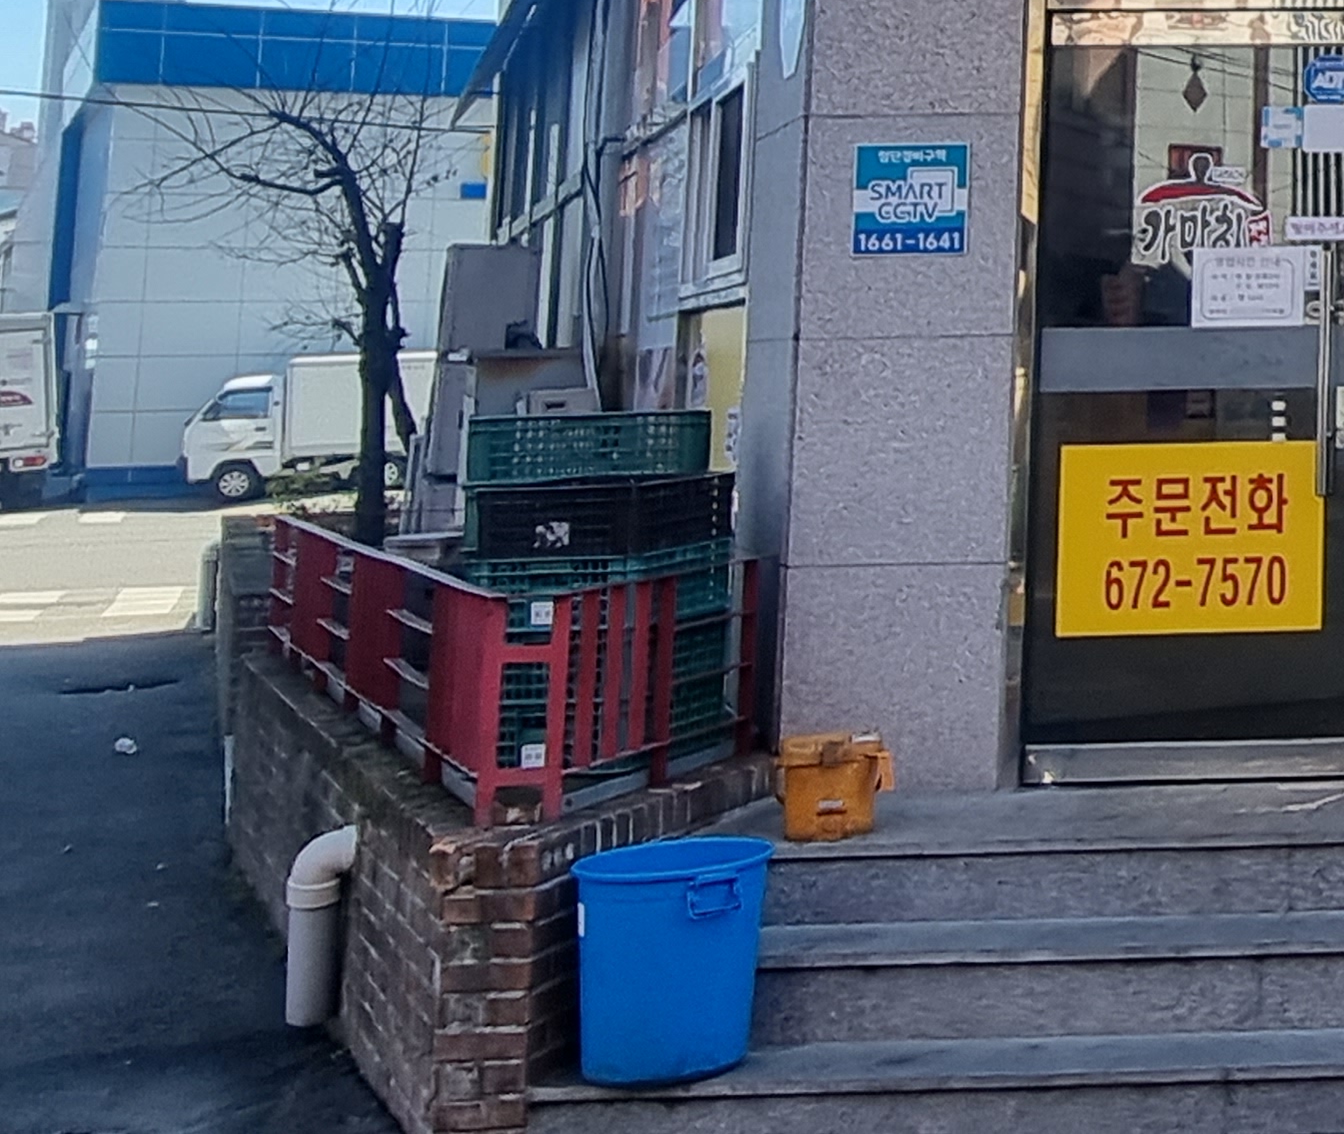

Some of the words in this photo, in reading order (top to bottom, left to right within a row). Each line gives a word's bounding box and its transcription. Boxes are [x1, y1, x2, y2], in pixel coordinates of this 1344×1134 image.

[870, 181, 948, 201] SMART
[877, 201, 939, 221] CCTV
[858, 231, 961, 252] 1661-1641
[1140, 202, 1246, 264] 가마치
[1105, 473, 1289, 539] 주문전화
[1104, 555, 1288, 611] 672-7570
